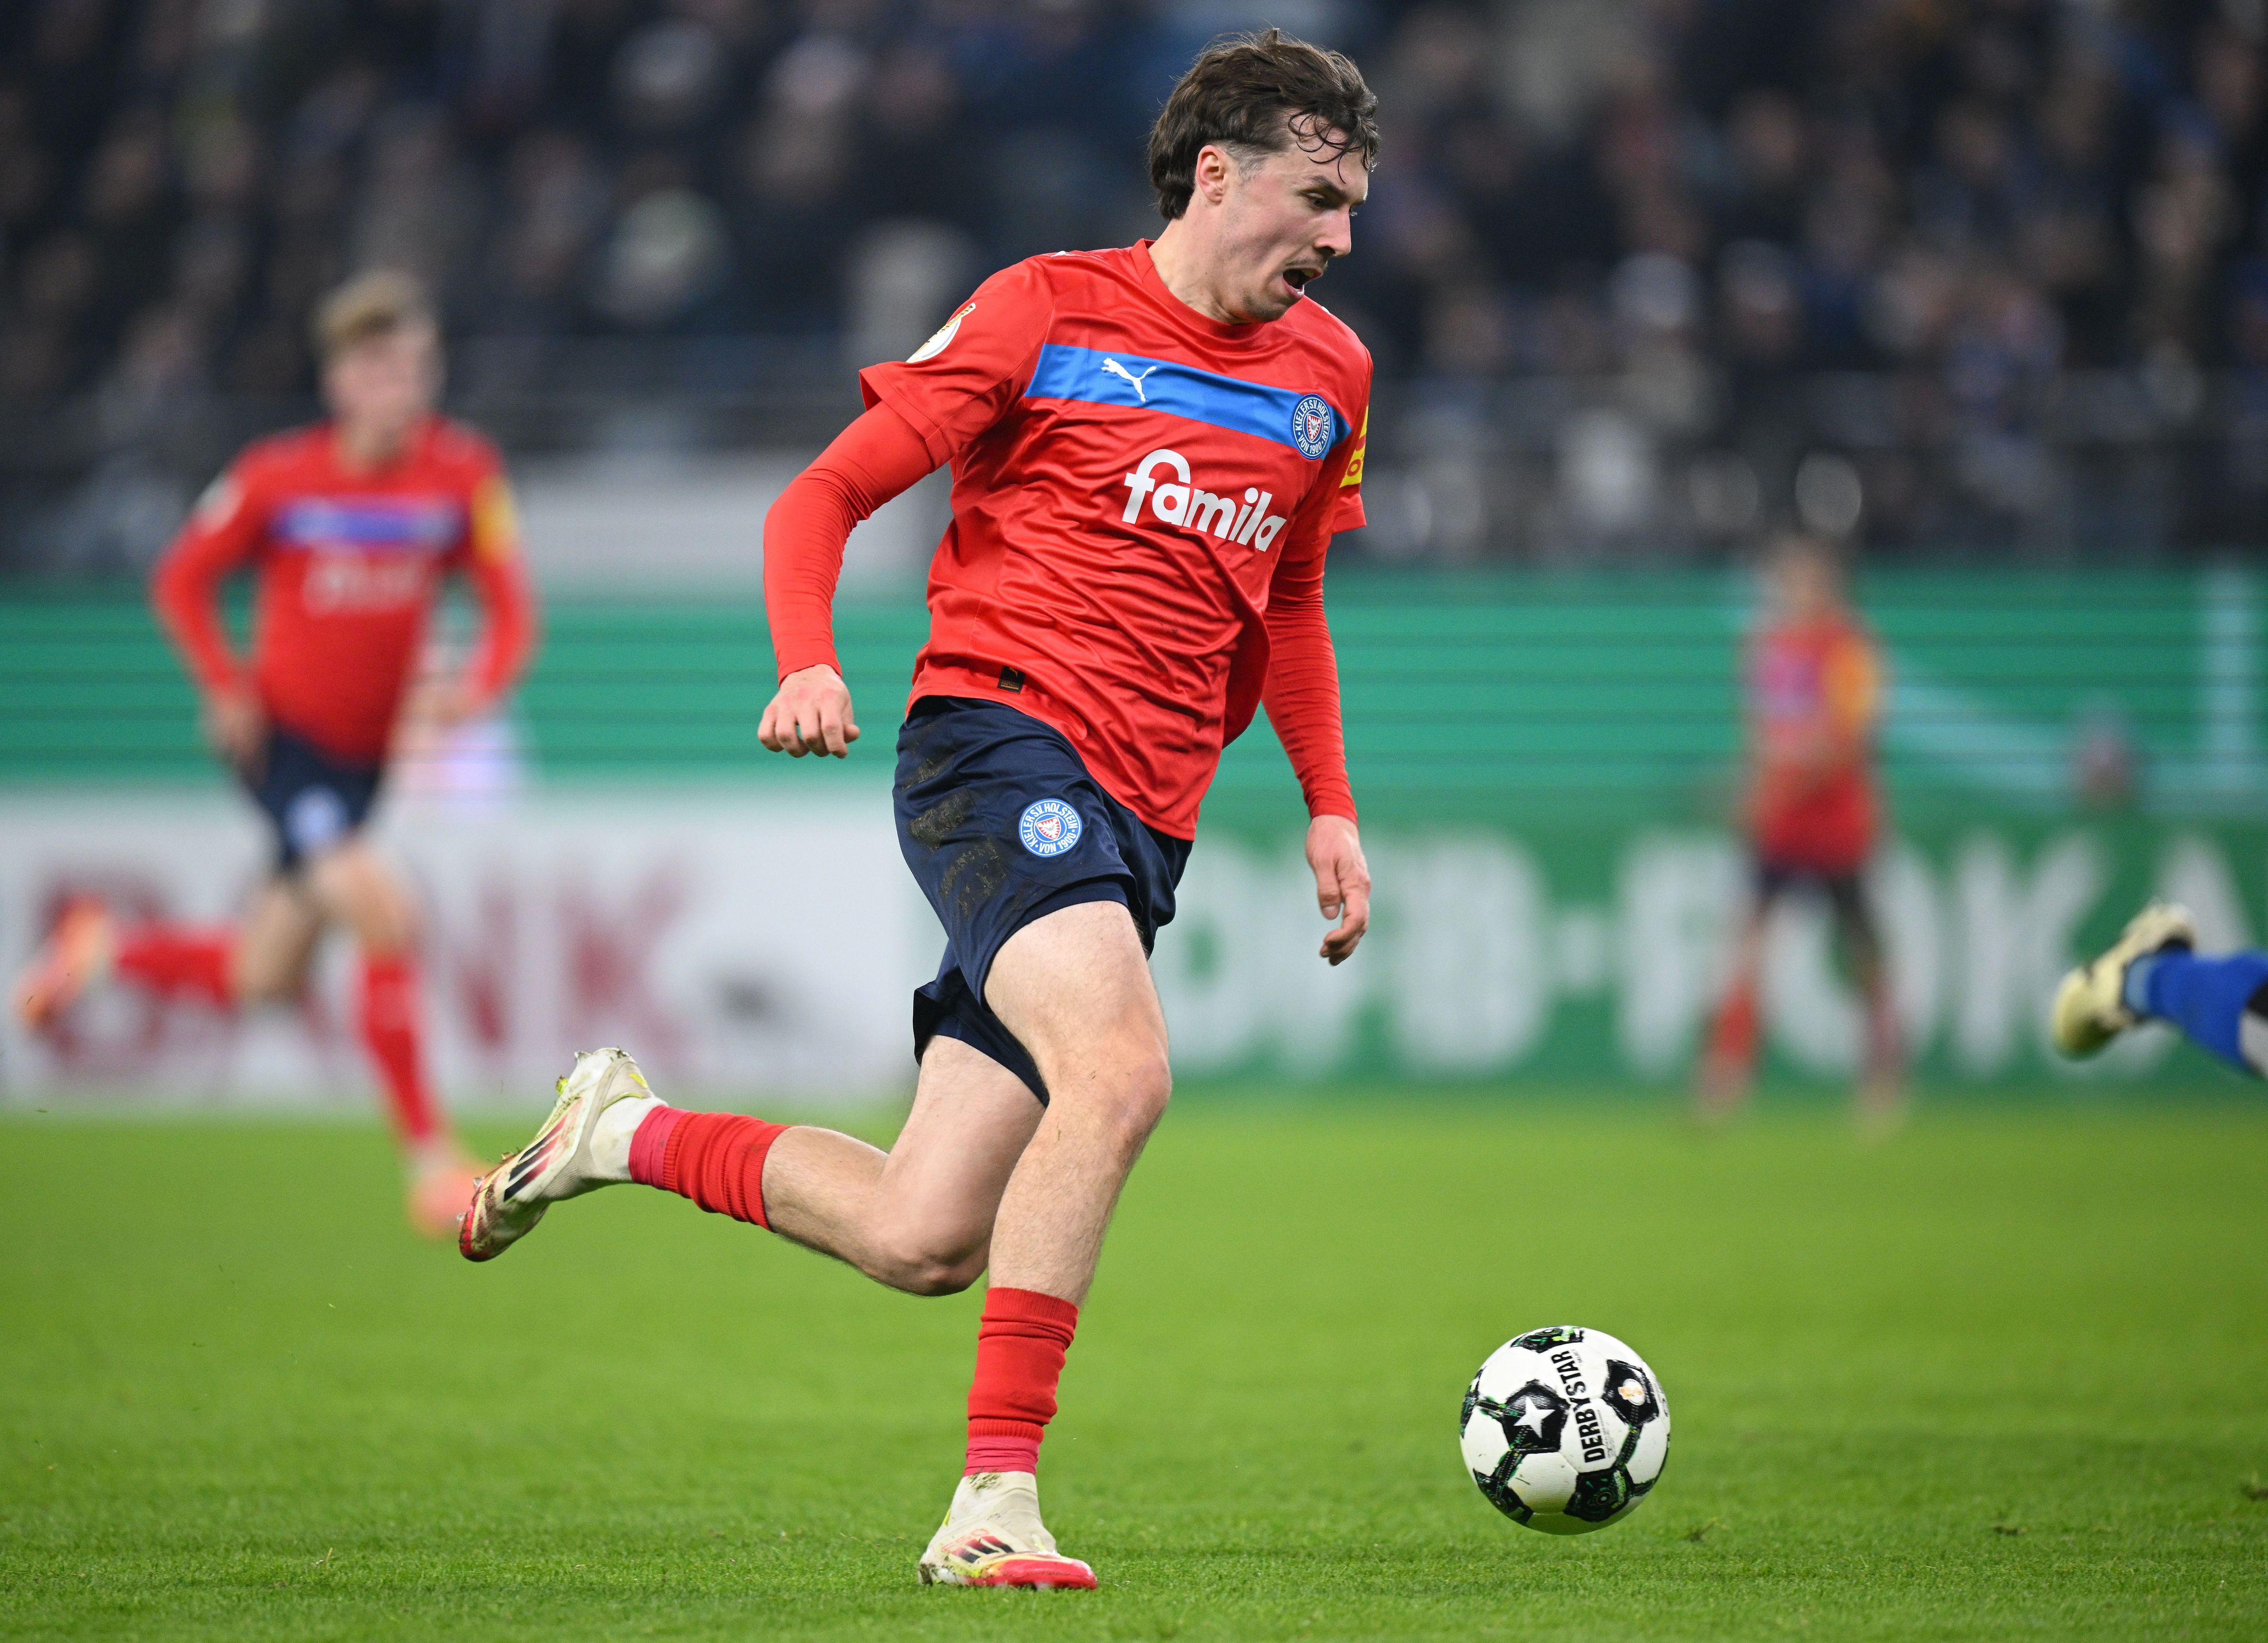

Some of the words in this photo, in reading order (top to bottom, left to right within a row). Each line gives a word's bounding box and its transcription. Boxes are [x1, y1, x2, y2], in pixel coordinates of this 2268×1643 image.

[1295, 402, 1310, 430] KIELER
[1317, 402, 1329, 441] HOLSTEIN
[1298, 434, 1310, 452] VON
[1310, 441, 1322, 454] 1900
[1122, 449, 1287, 552] famila
[1030, 804, 1045, 818] S.V.
[1044, 803, 1078, 829] HOLSTEIN
[1023, 815, 1038, 847] KIELER
[1039, 843, 1057, 854] VON
[1057, 832, 1076, 849] 1900
[1551, 1350, 1606, 1463] DERBYSTAR
